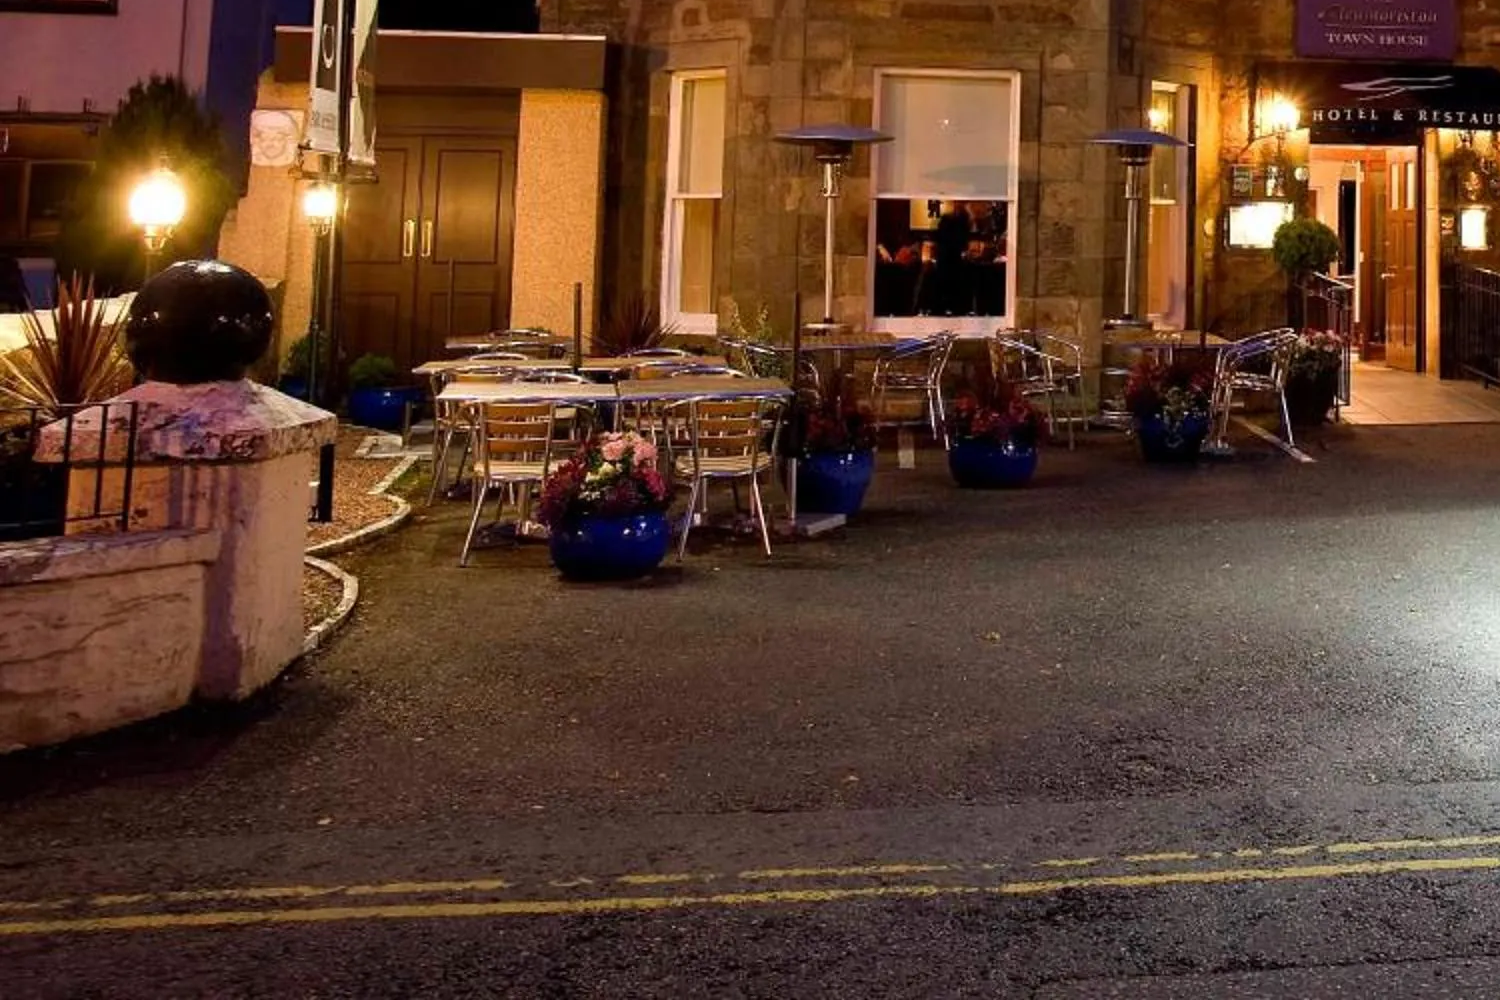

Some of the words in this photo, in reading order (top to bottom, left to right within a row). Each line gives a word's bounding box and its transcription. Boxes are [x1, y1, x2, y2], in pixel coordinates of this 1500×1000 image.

[1325, 32, 1374, 44] TOWN
[1379, 34, 1428, 46] HOUSE
[1312, 108, 1379, 122] HOTEL
[1392, 109, 1404, 122] &
